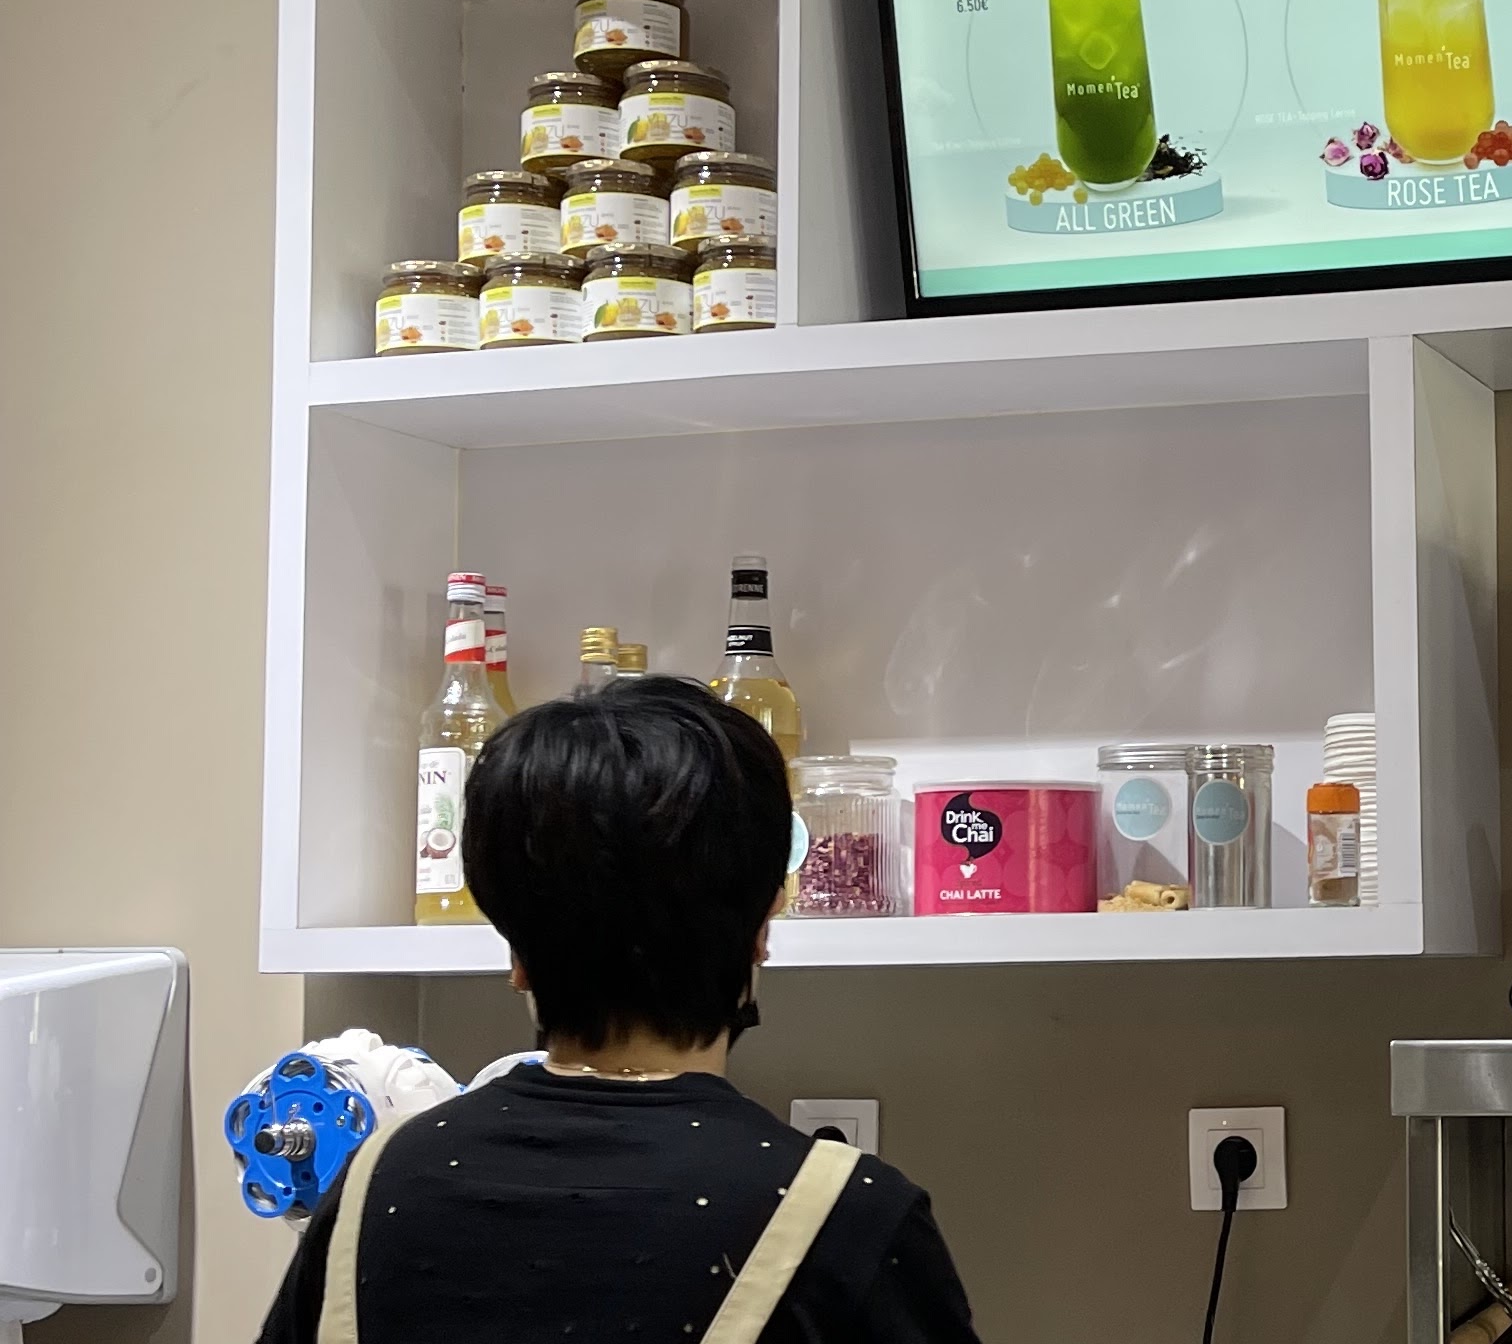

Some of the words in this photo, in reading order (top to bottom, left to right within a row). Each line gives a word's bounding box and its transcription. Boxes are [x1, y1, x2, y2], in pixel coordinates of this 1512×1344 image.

[1386, 177, 1450, 208] ROSE
[1453, 172, 1500, 202] TEA
[1055, 202, 1097, 233] ALL
[1103, 197, 1177, 228] GREEN
[945, 809, 984, 825] Drink
[971, 822, 988, 830] me
[952, 823, 994, 843] Chai
[940, 889, 964, 900] CHAI
[966, 888, 1001, 900] LATTE
